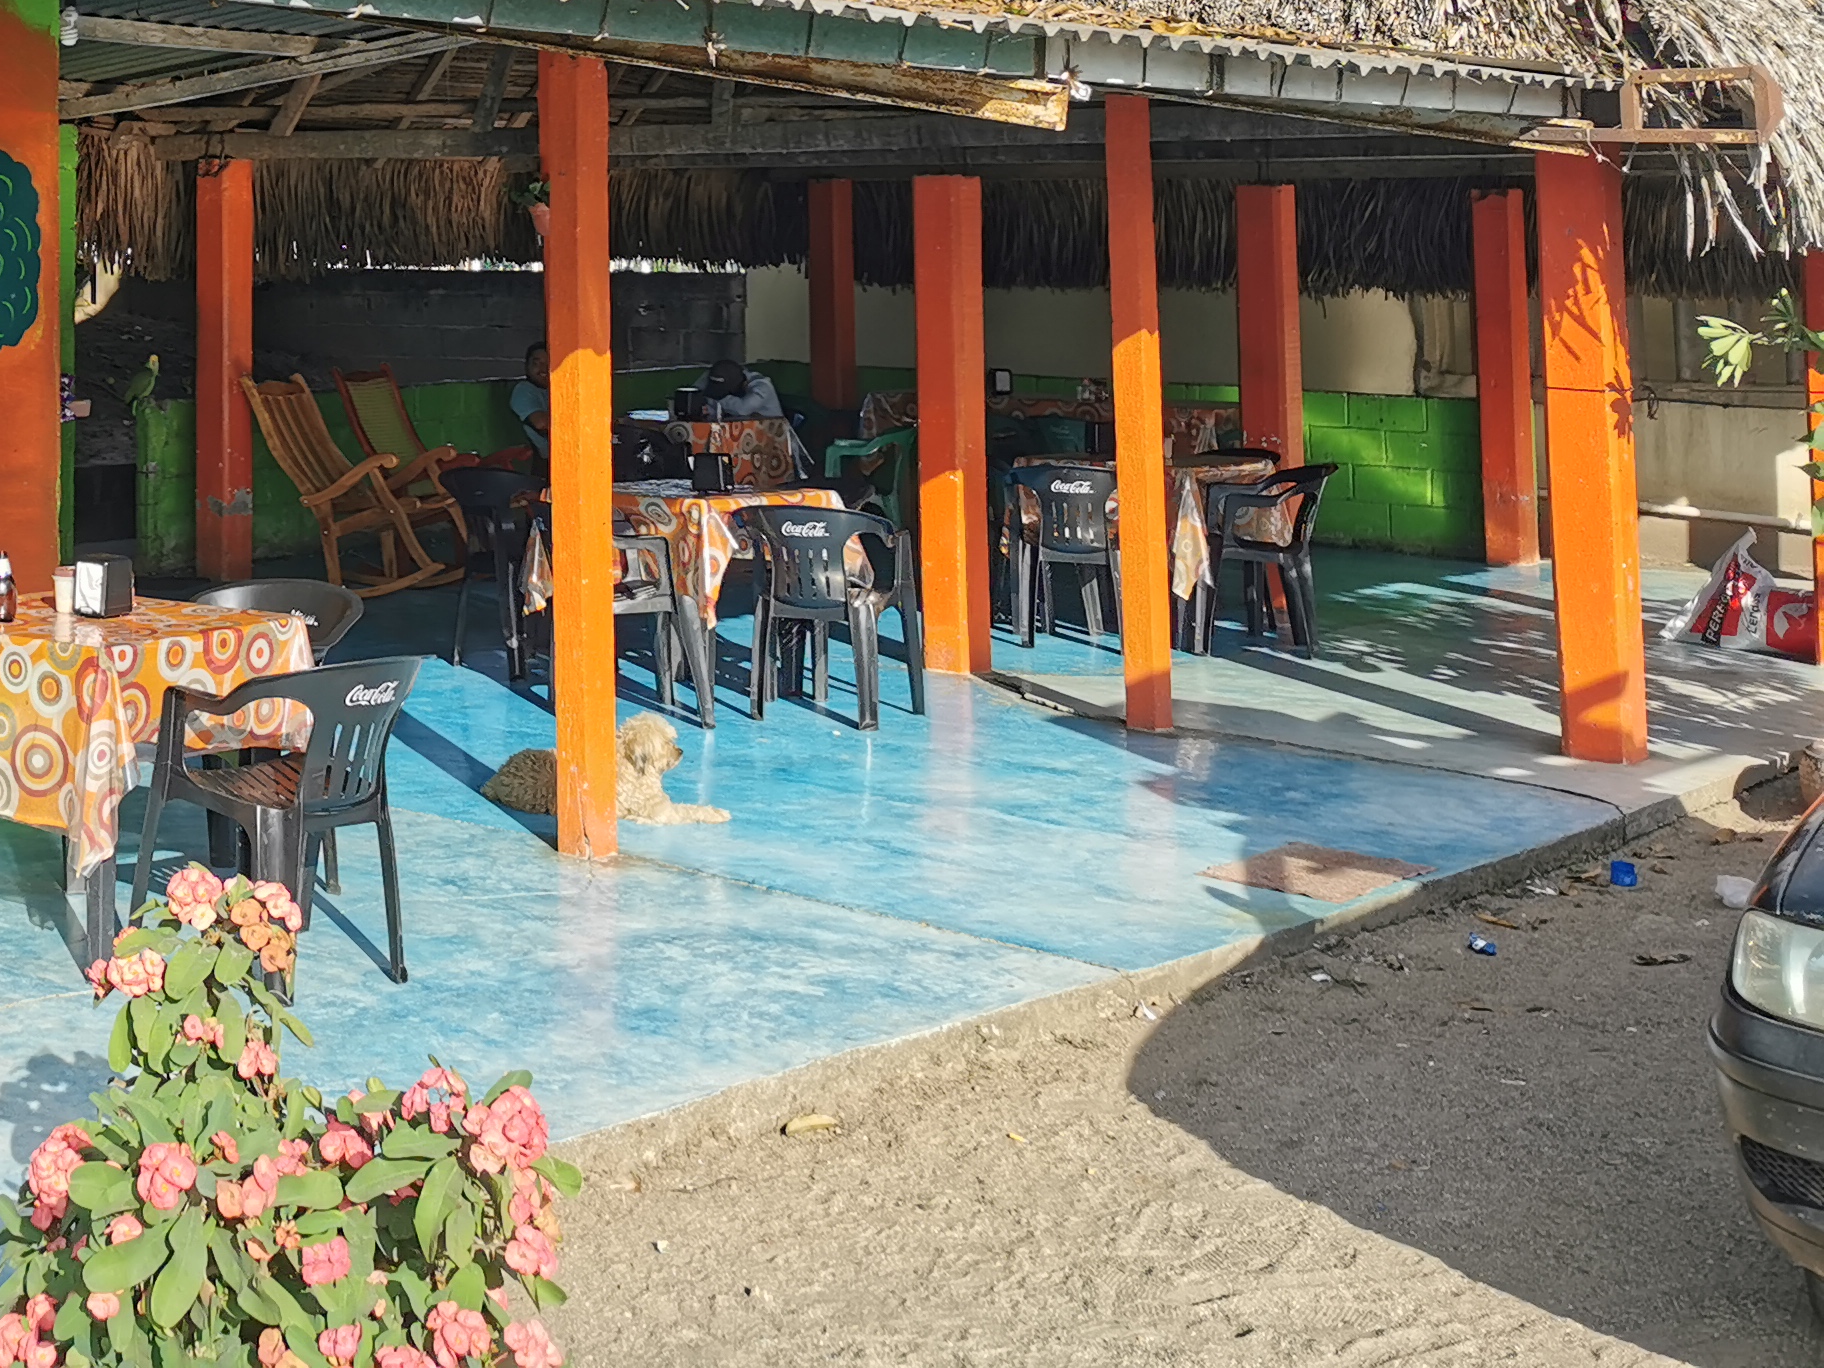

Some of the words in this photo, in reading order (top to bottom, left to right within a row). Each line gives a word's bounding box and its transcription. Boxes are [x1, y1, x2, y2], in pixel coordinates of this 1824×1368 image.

[1051, 479, 1092, 493] Coca-Cola
[781, 520, 827, 537] Coca-Cola
[345, 680, 399, 707] Coca-Cola
